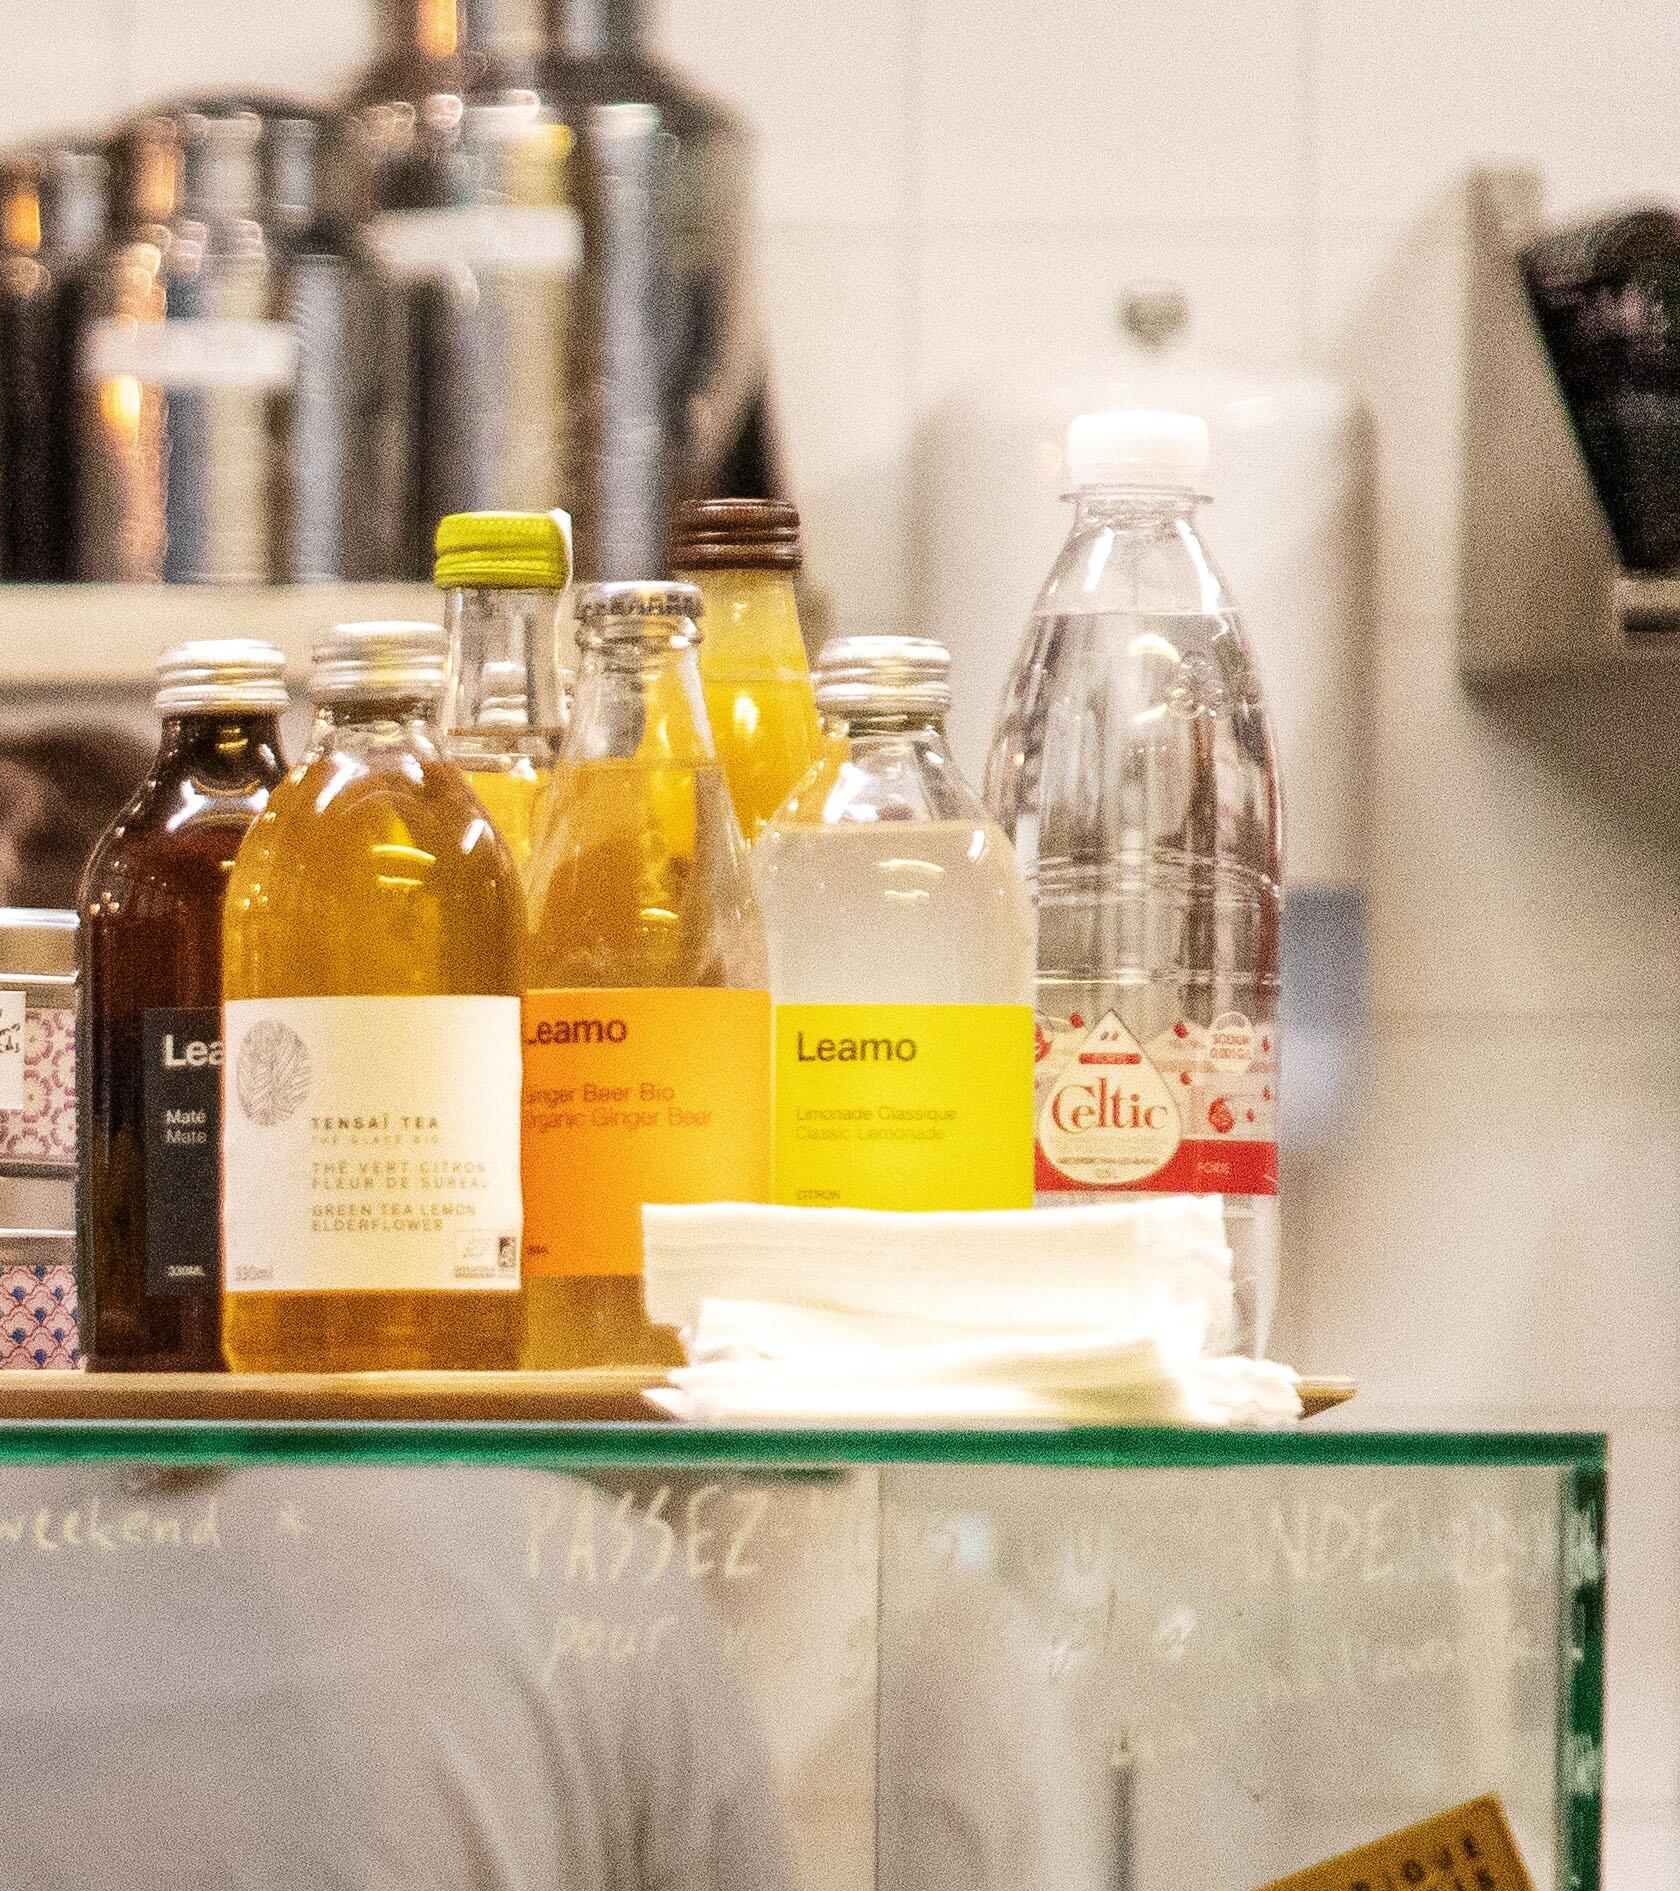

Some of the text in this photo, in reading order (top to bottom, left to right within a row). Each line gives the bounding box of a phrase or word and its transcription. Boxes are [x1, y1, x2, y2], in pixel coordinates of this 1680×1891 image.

[796, 1031, 919, 1063] Leamo
[1051, 1077, 1168, 1133] Celtic
[401, 1116, 439, 1130] TEA
